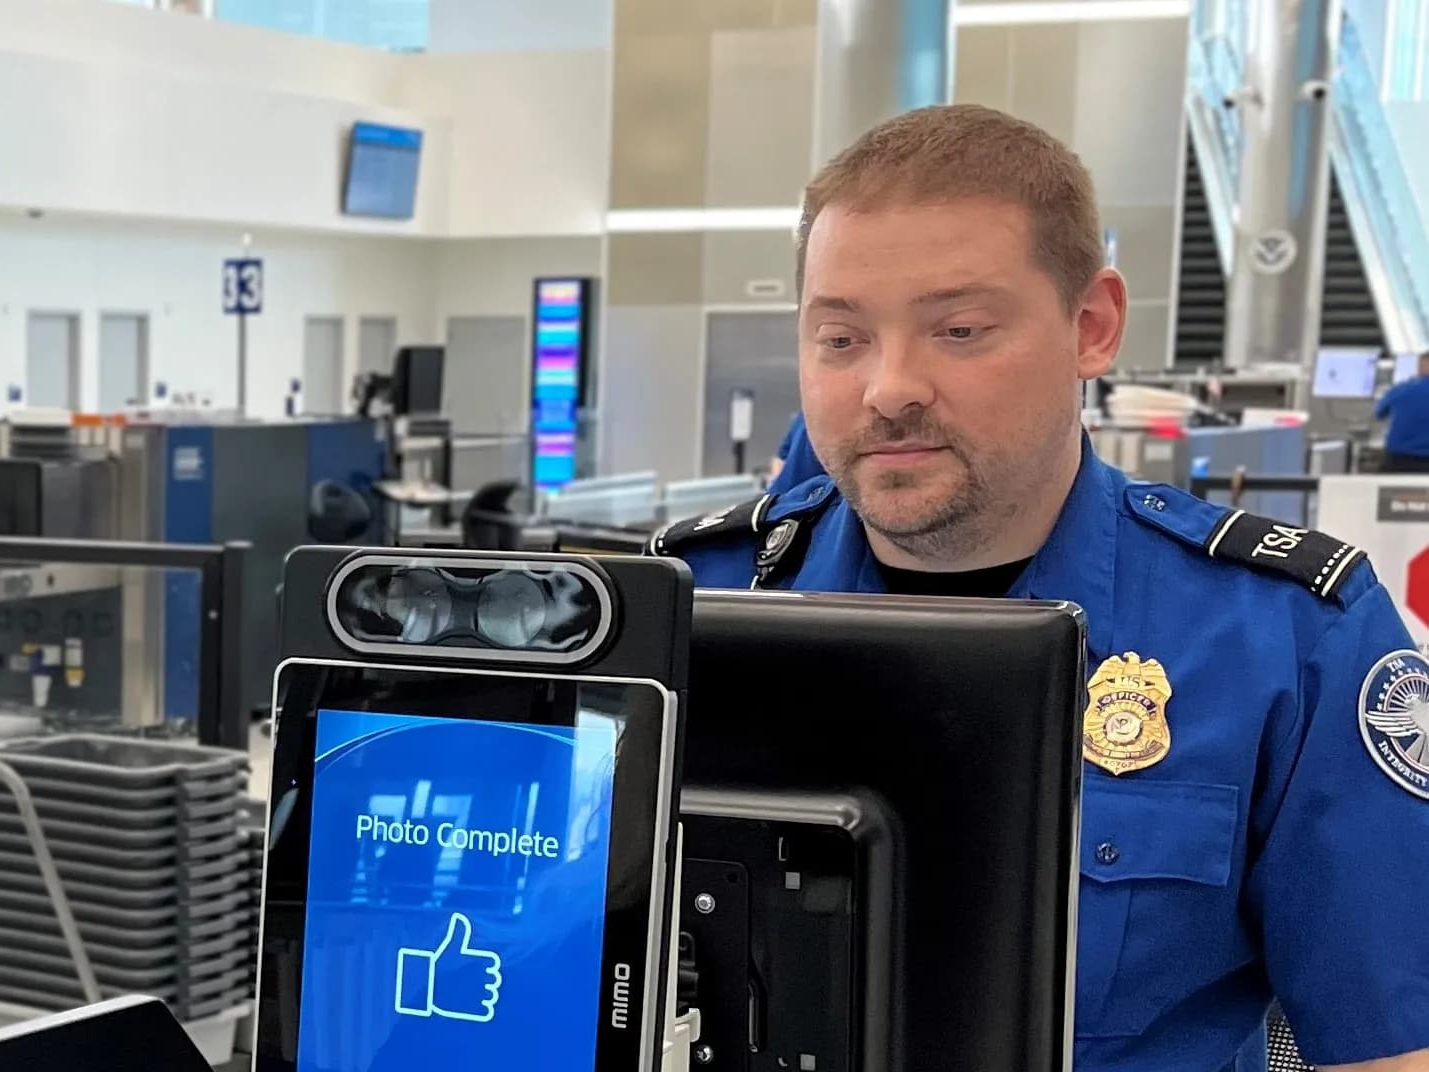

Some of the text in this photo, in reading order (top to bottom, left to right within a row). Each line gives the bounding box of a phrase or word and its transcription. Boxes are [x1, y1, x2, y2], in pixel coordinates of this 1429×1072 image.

[1251, 524, 1309, 558] TSA
[1378, 740, 1428, 788] INTEGRITY
[356, 814, 559, 858] Photo Complete
[612, 963, 630, 1029] mimo
